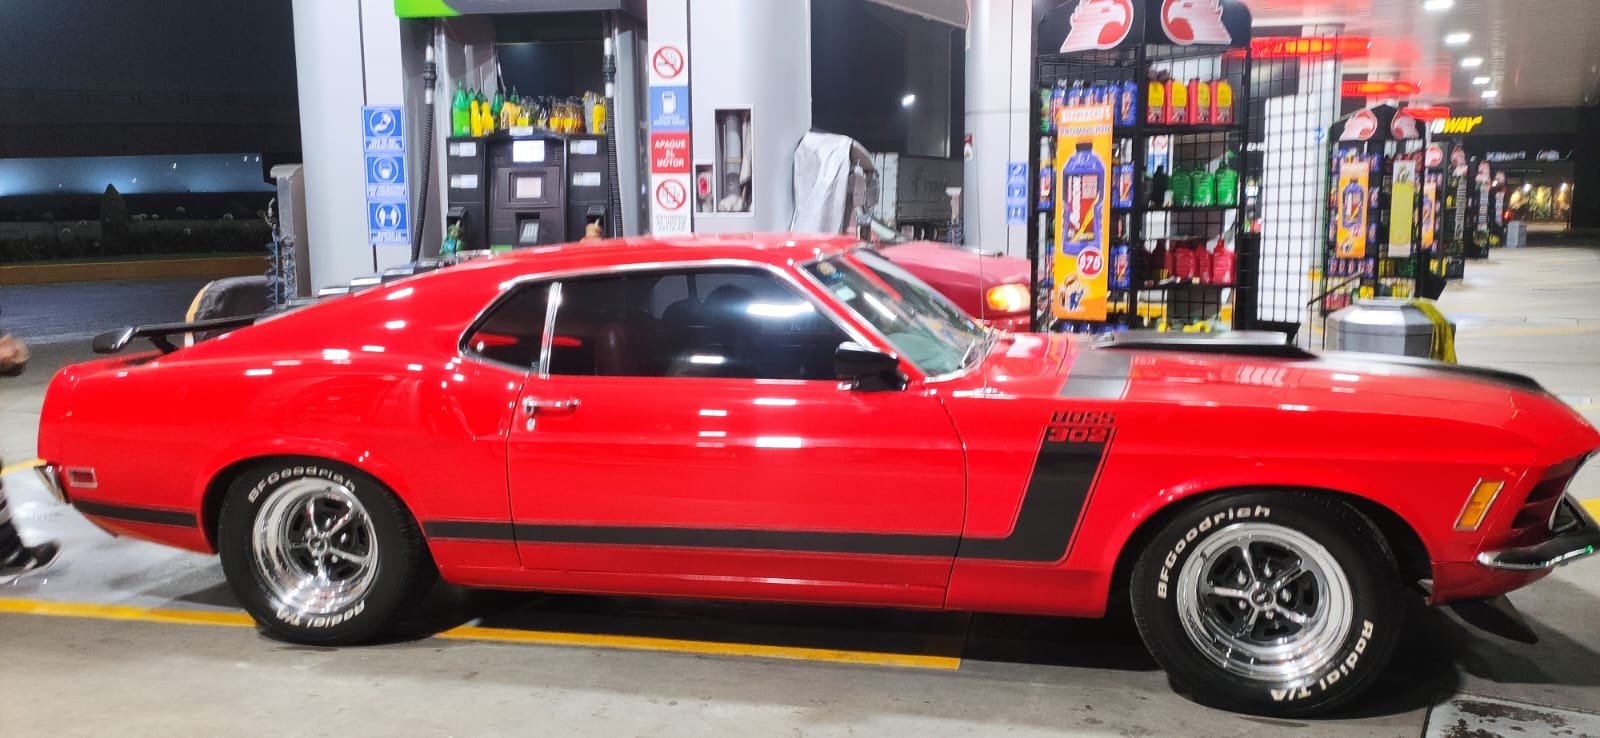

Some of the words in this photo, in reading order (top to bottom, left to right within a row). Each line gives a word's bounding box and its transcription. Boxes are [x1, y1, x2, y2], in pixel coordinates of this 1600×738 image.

[654, 138, 687, 150] APAGUE
[665, 149, 676, 159] EL
[656, 157, 686, 168] MOTOR
[1050, 411, 1117, 425] BOSS
[1047, 427, 1108, 442] 302
[248, 466, 357, 504] BFGoodrich
[1156, 504, 1272, 600] BFGoodrich
[307, 601, 366, 629] Radial
[1319, 619, 1374, 691] Radial
[1271, 686, 1312, 703] T/A
